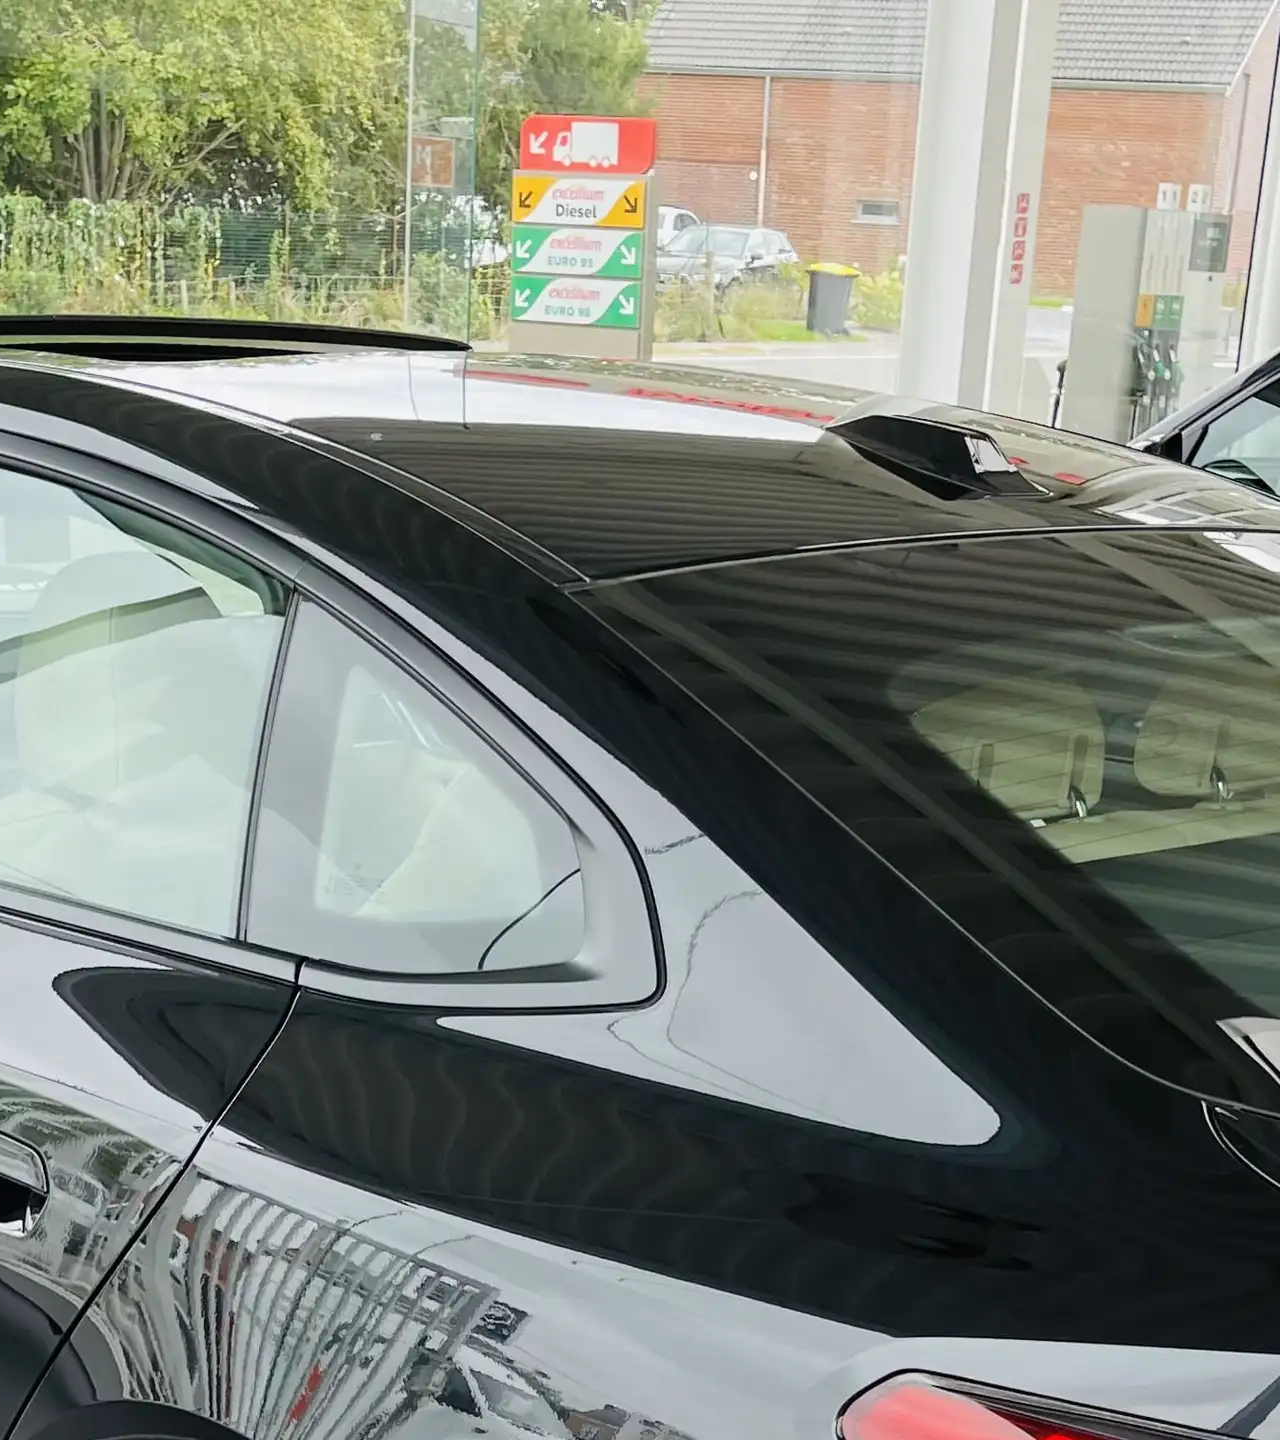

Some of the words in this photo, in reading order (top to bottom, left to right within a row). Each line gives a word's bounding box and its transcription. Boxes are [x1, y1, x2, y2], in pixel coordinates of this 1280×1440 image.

[555, 203, 597, 219] Diesel
[547, 255, 578, 267] EURO
[544, 304, 575, 317] EURO
